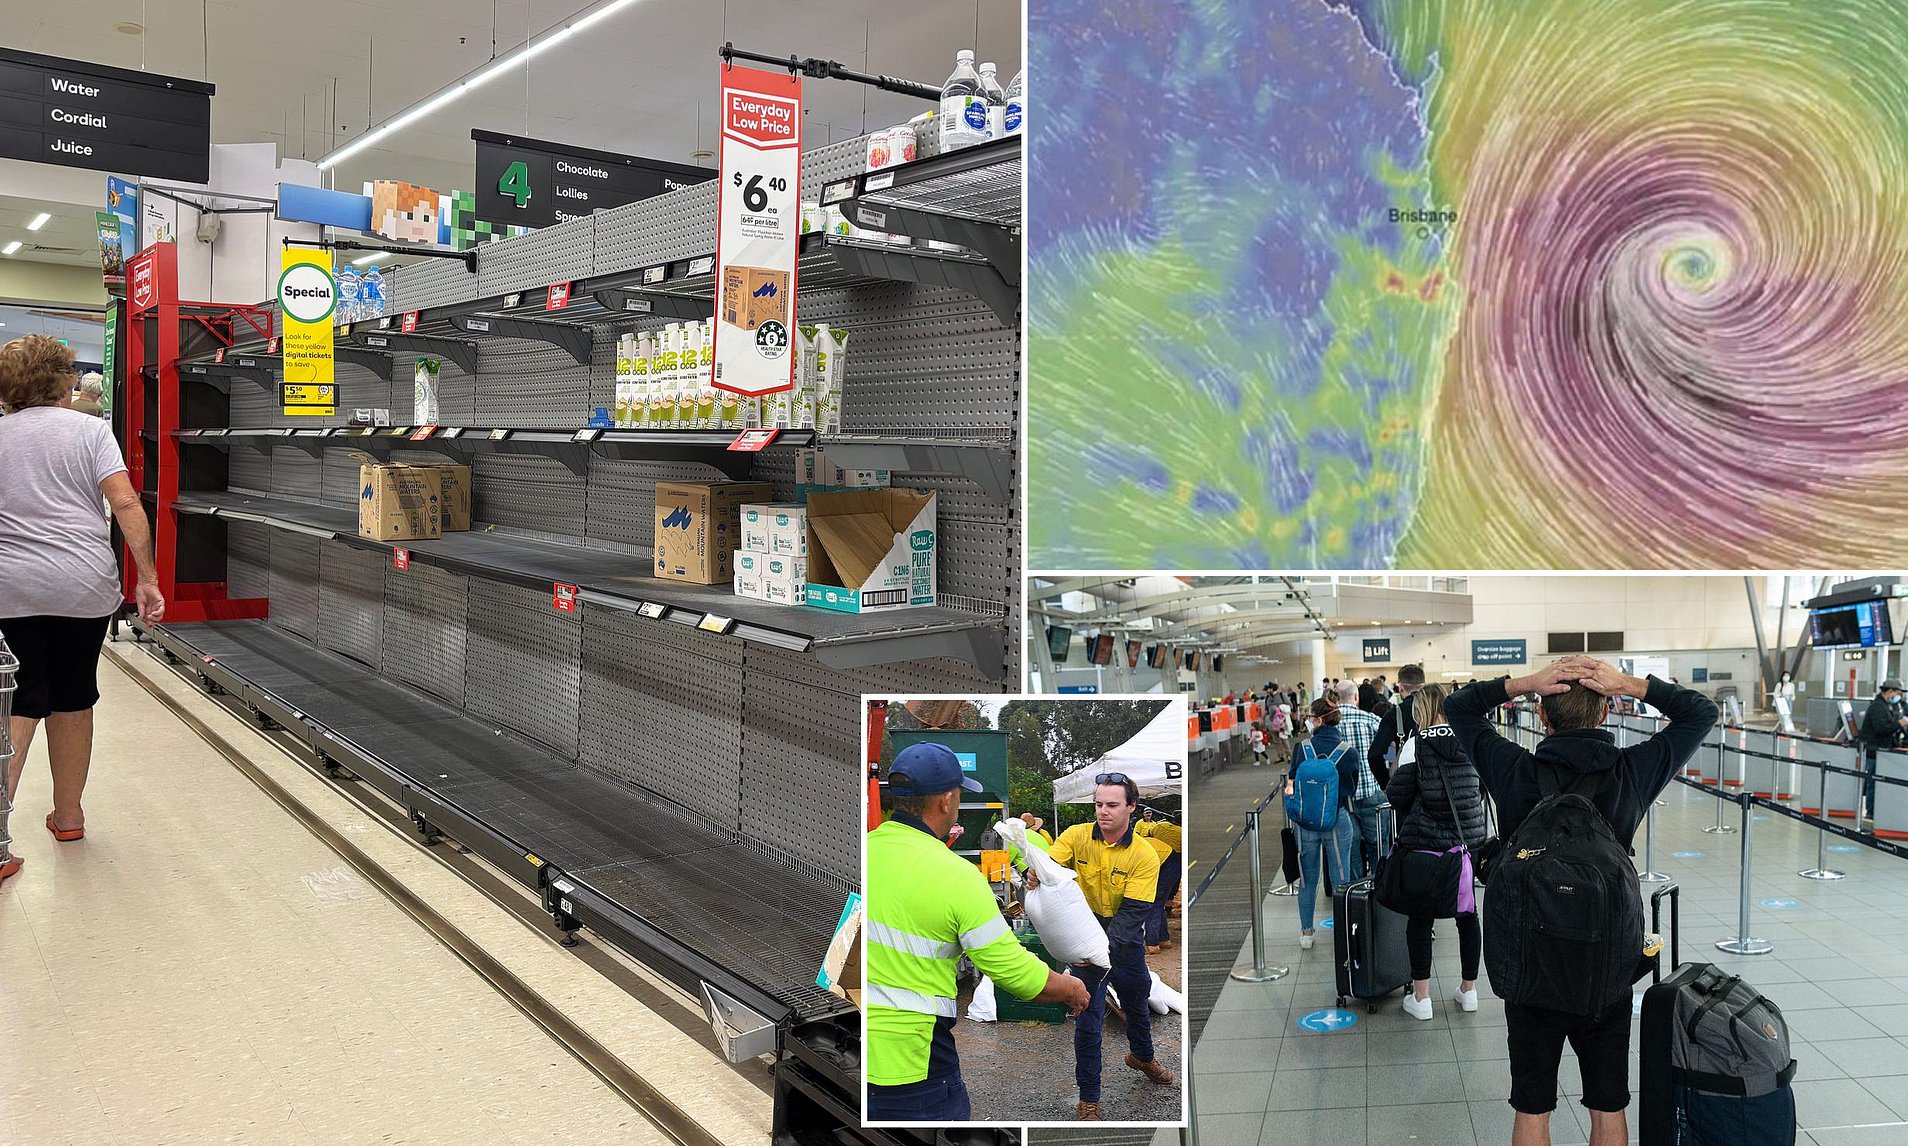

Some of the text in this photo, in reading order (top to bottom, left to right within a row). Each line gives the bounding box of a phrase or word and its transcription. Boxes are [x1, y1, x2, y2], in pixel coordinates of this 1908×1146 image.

[51, 78, 100, 97] Water
[733, 96, 791, 121] Everyday
[51, 108, 107, 128] Cordial
[733, 114, 790, 134] Low Price
[51, 139, 93, 155] Juice
[556, 161, 609, 179] Chocolate
[497, 161, 532, 208] 4
[556, 186, 589, 200] Lollies
[555, 211, 583, 223] Spre
[284, 285, 331, 299] Special
[769, 335, 775, 345] 5
[911, 551, 931, 568] PURE
[912, 585, 931, 596] WATER
[1373, 647, 1389, 656] Lift
